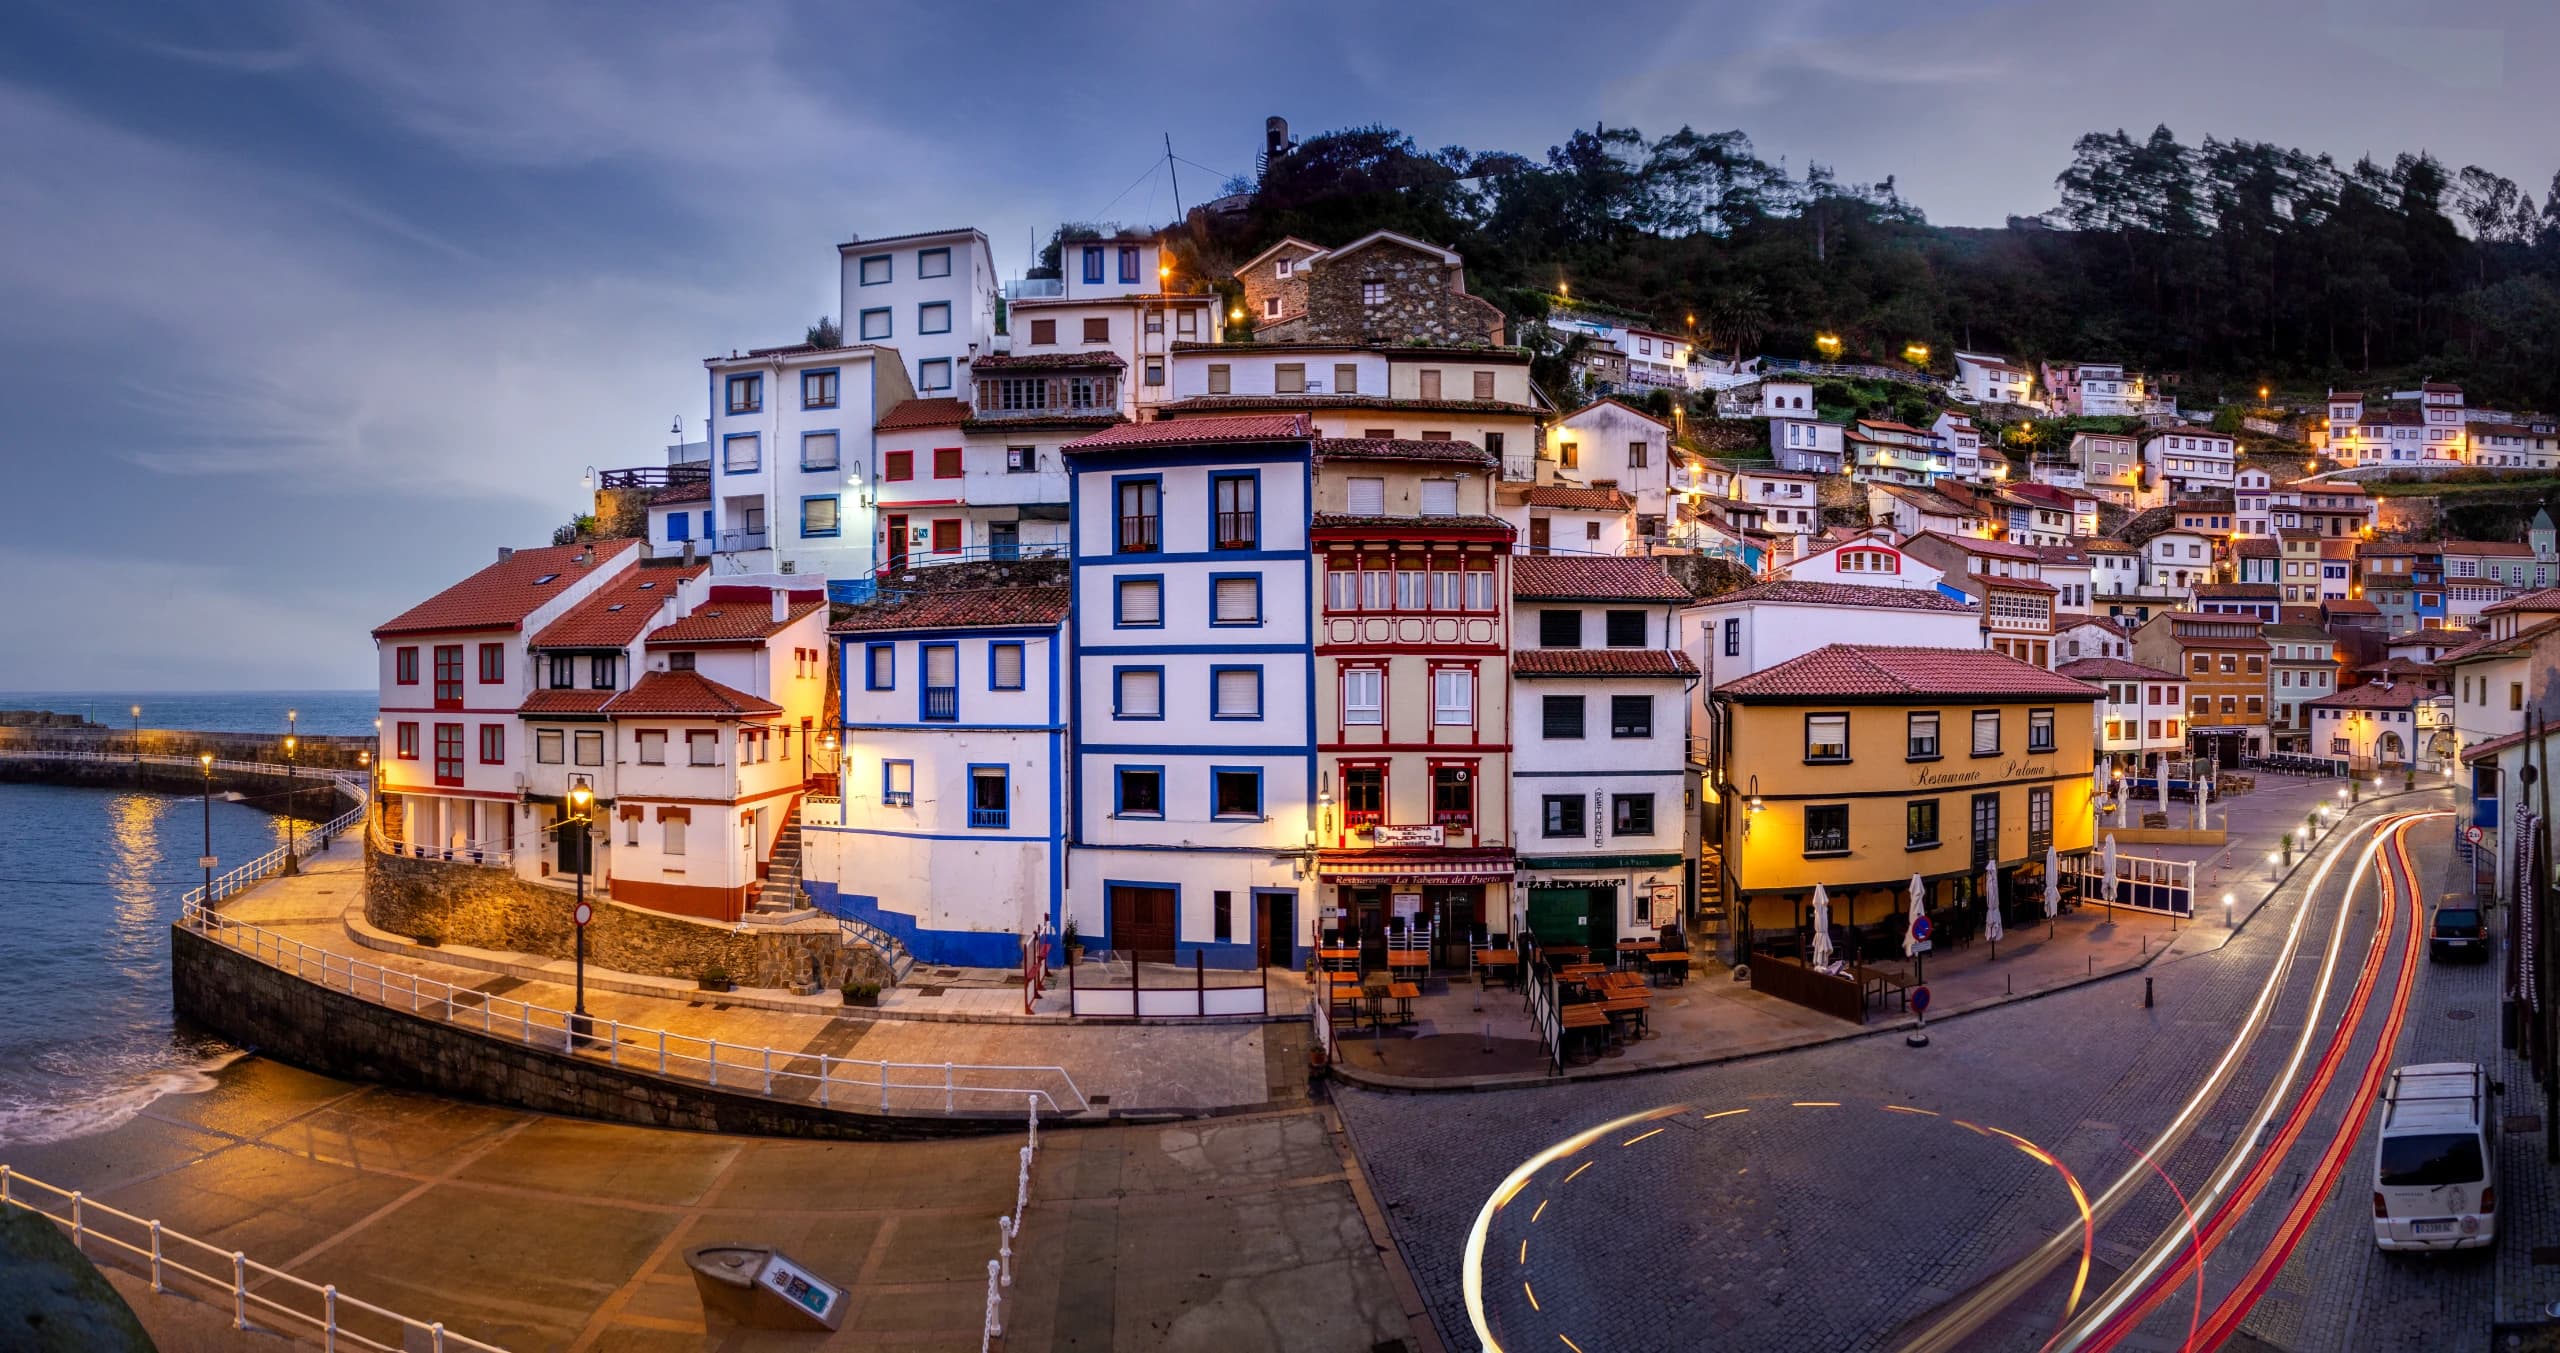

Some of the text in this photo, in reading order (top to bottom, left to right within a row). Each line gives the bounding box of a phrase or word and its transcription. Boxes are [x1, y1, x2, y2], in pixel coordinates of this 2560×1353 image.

[1911, 759, 2045, 786] Restaurante Paloma
[1335, 874, 1501, 884] Restaurante La Taberna del Puerto
[1524, 879, 1623, 889] BAR LA PARRA
